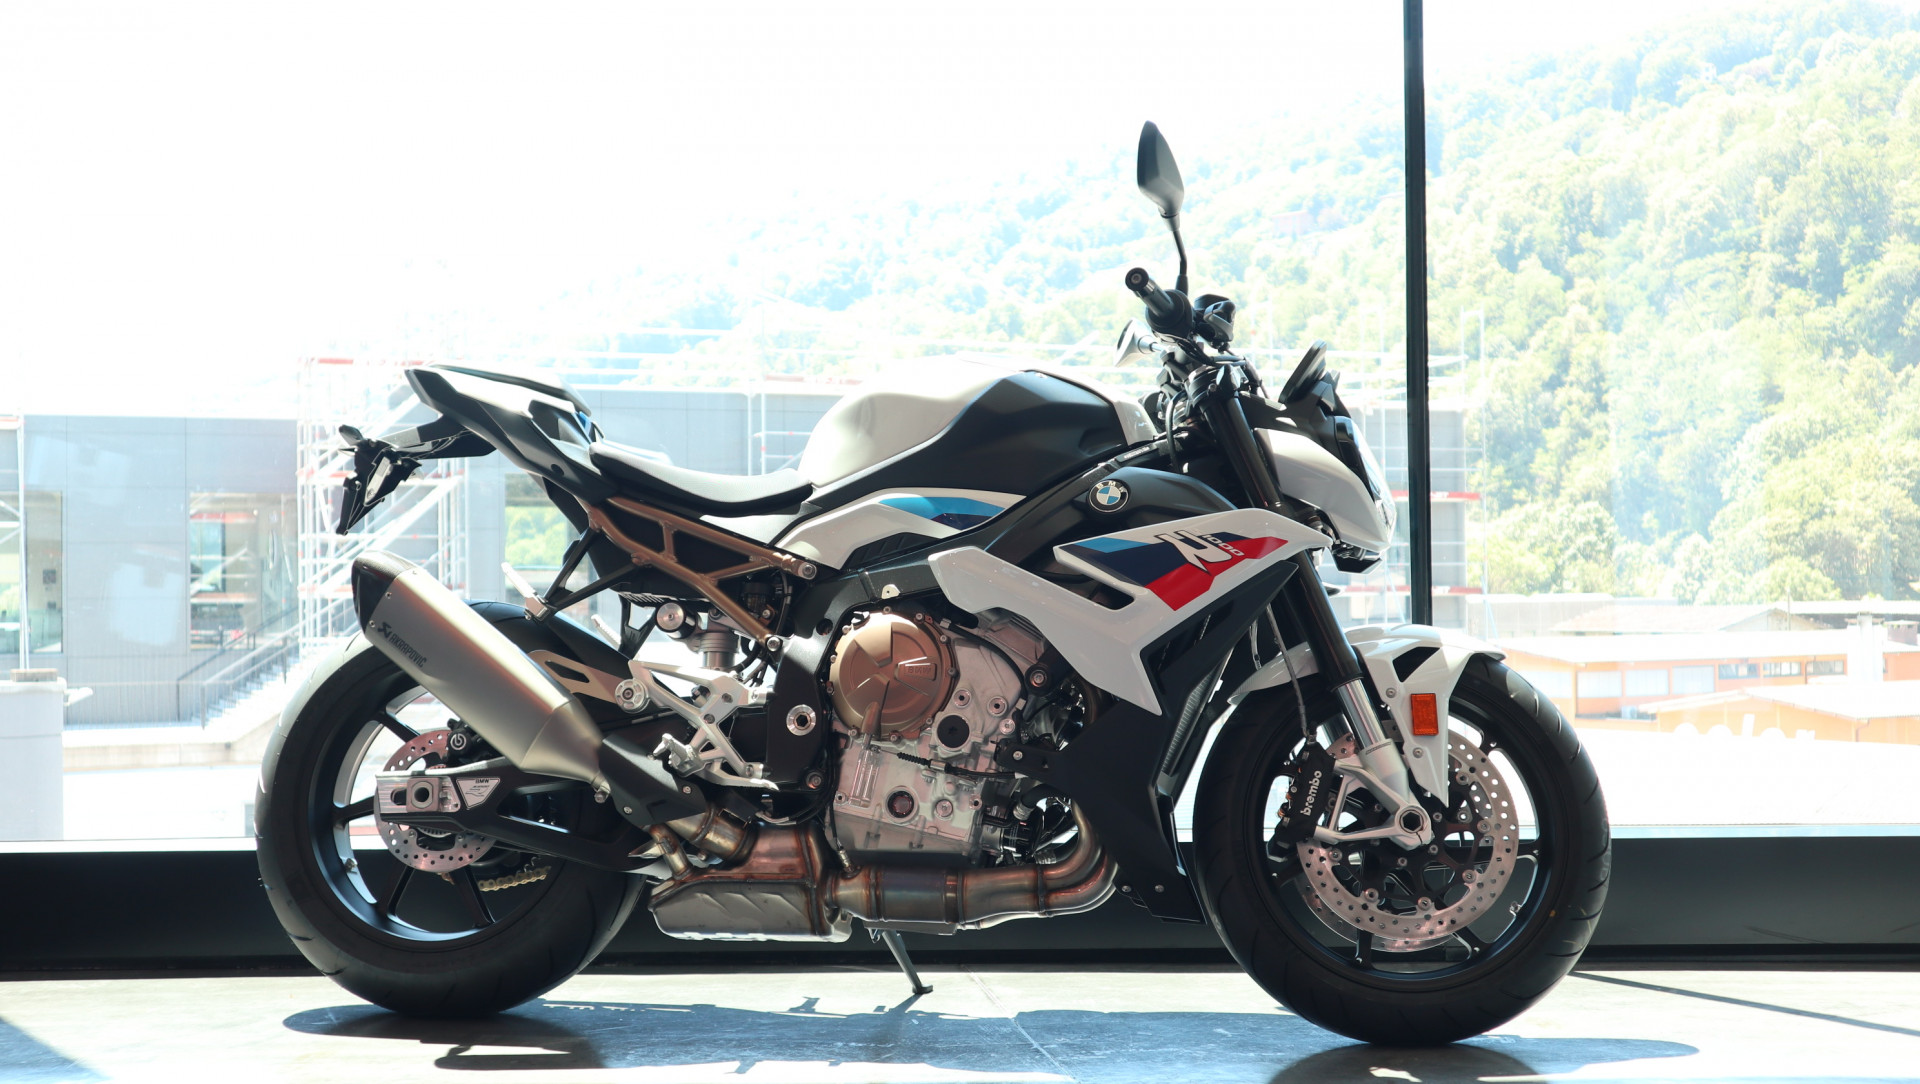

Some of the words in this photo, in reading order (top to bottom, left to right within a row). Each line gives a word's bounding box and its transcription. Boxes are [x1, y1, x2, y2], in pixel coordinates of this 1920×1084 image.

[1096, 481, 1127, 493] BMW
[1202, 534, 1245, 556] 1000
[907, 666, 931, 674] BMW
[1300, 770, 1322, 816] brembo
